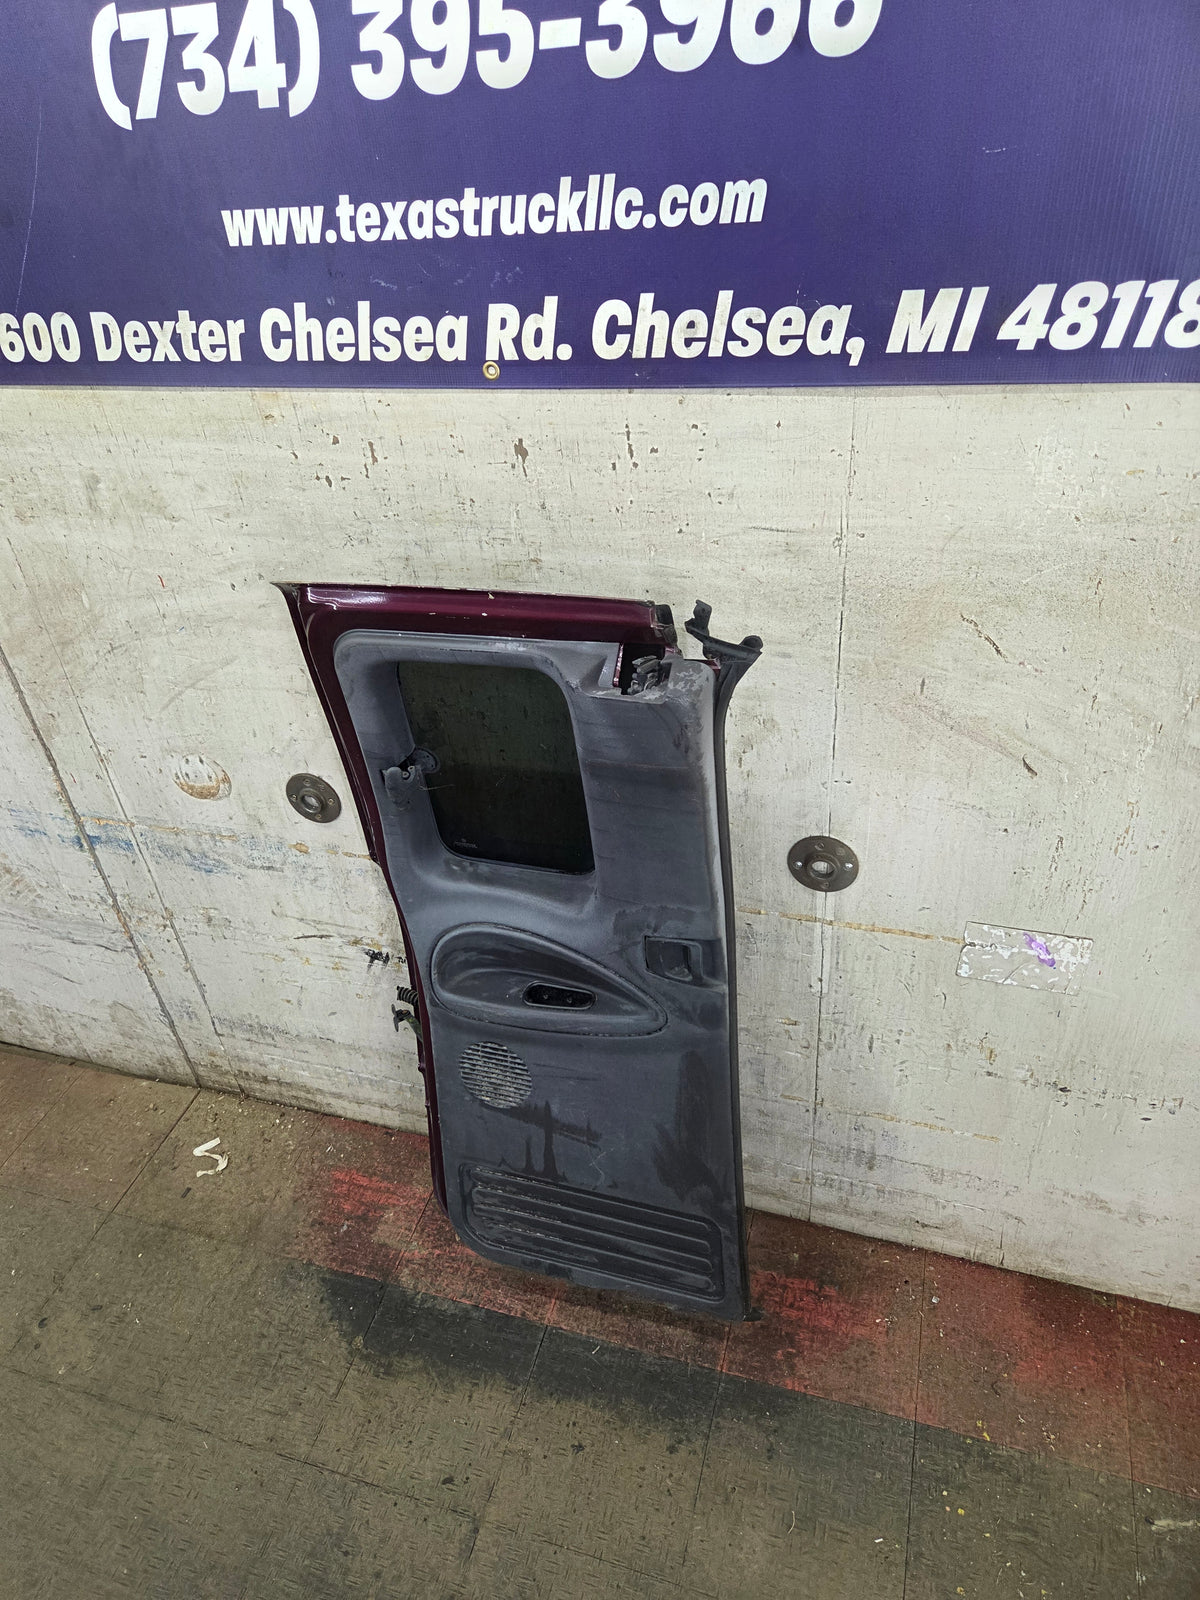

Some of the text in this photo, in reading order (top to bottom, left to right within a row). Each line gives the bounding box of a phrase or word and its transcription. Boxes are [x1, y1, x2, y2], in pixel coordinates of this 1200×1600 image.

[91, 0, 320, 130] (734)
[221, 173, 768, 247] www.texastruckllc.com
[0, 278, 1200, 367] 600 Dexter Chelsea Rd. Chelsea, MI 48118
